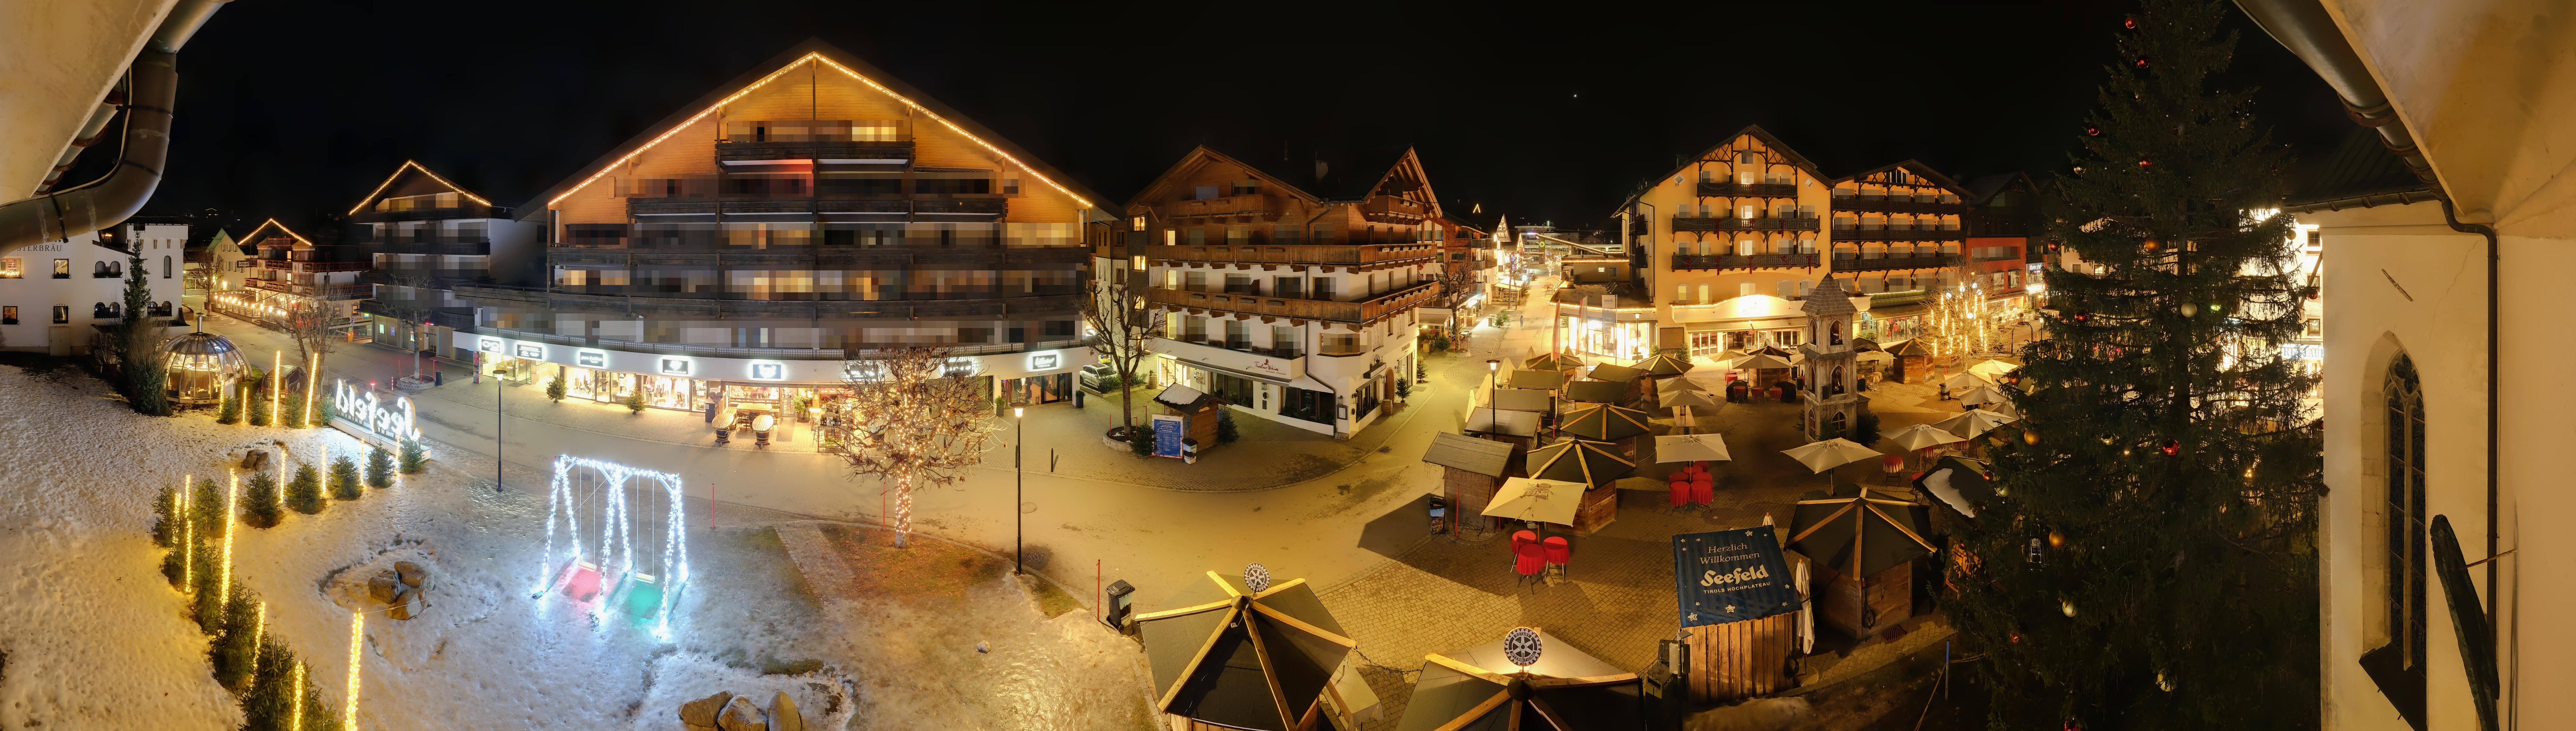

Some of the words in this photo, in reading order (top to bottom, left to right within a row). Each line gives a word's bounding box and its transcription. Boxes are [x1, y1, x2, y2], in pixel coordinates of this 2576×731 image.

[1371, 364, 1385, 377] RESTAURANT
[1708, 543, 1747, 553] Herzlich
[1700, 553, 1760, 564] Willkommen
[1700, 564, 1769, 586] Seefeld
[1248, 578, 1265, 589] INTERNAIONAL
[1727, 582, 1770, 591] HOCHPLATEAU
